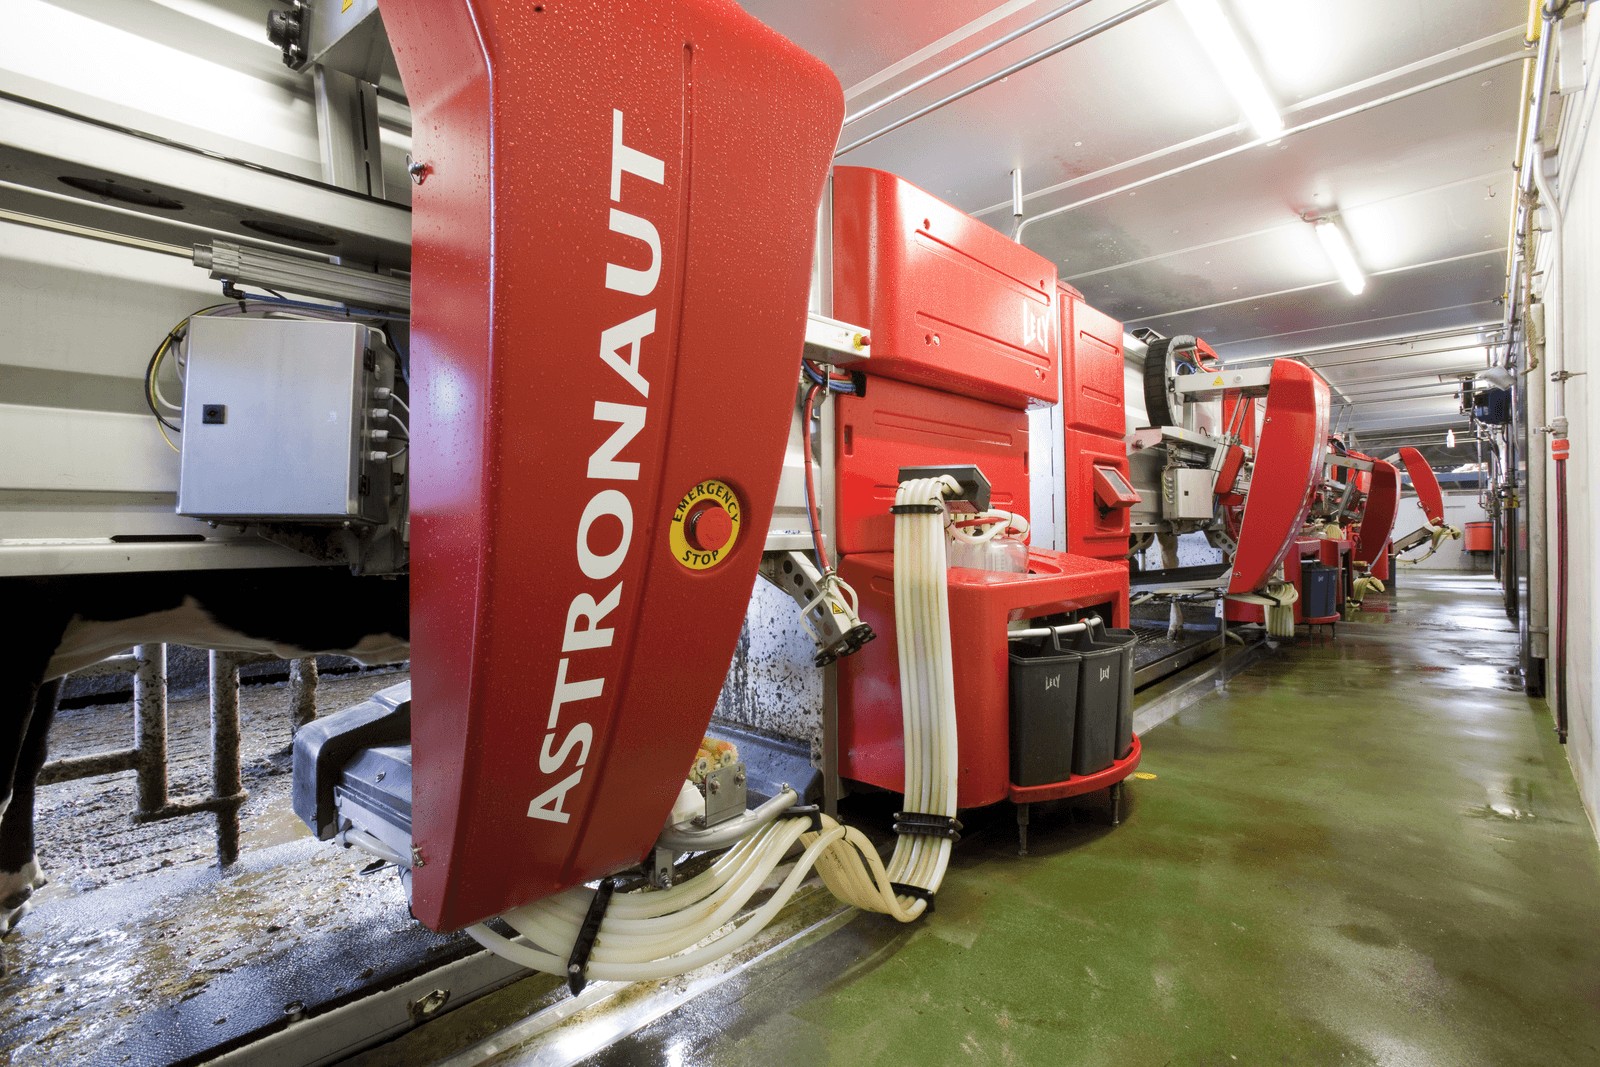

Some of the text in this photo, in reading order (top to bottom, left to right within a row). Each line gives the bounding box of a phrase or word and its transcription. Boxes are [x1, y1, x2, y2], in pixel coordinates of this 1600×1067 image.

[527, 108, 666, 825] ASTRONAUT
[672, 482, 738, 522] EMERGENCY
[682, 549, 719, 566] STOP
[1045, 674, 1061, 690] LELY
